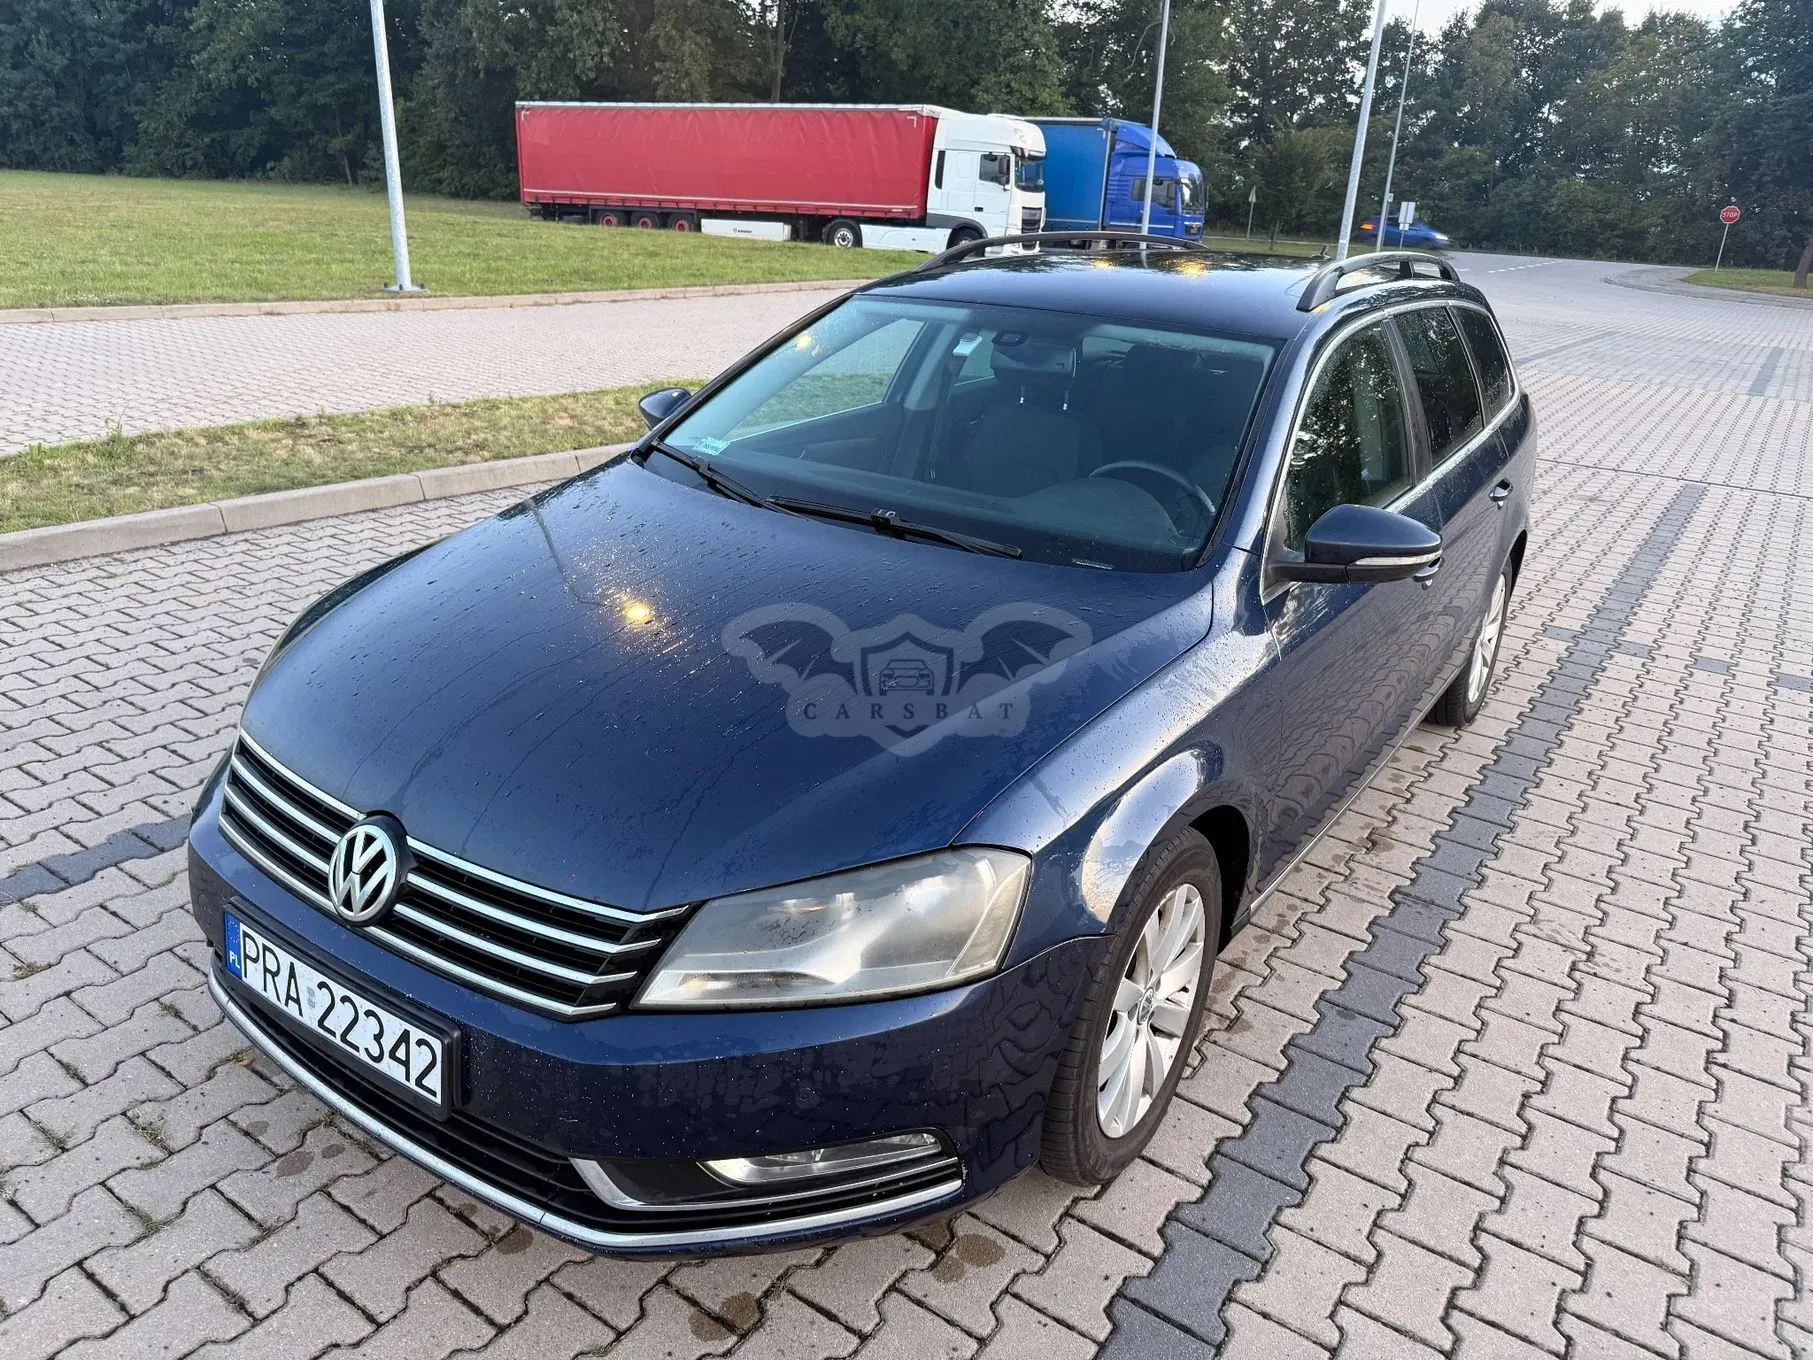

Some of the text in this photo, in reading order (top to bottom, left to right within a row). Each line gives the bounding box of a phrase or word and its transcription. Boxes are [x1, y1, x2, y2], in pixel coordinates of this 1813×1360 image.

[229, 951, 241, 969] PL
[242, 929, 437, 1098] PRA 22342
